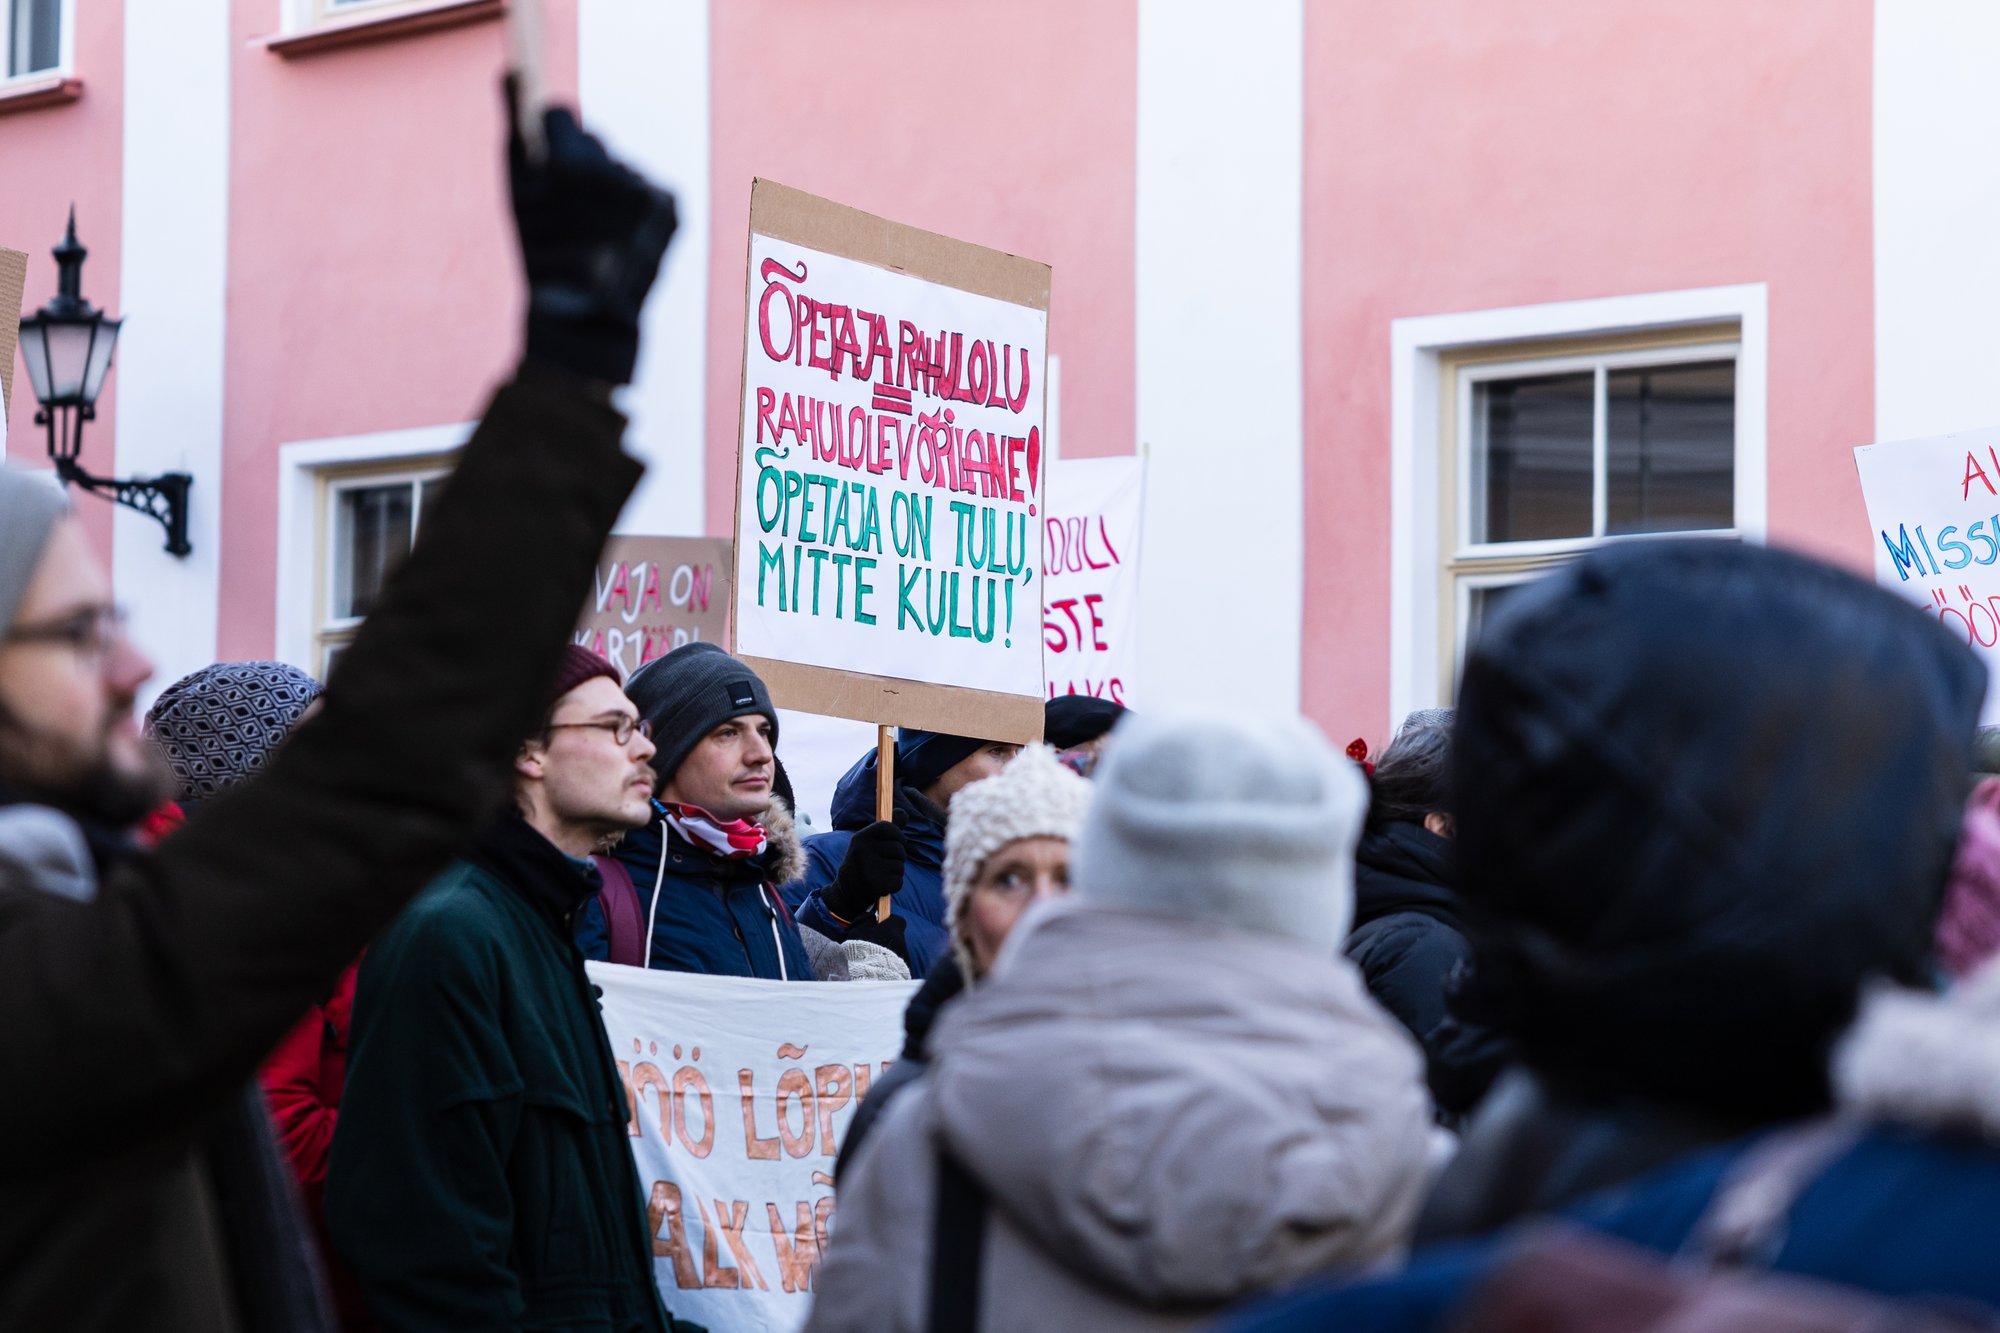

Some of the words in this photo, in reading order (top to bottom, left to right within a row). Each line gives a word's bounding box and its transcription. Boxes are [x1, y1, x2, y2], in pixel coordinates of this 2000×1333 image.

[758, 257, 894, 386] ÕPETAJA
[896, 319, 1031, 414] RAHULOLU
[756, 386, 916, 481] RAHULOLEV
[755, 446, 883, 555] ÕPETAJA
[891, 490, 933, 562] ON
[949, 500, 1033, 587] TULU,
[669, 563, 714, 614] ON
[757, 540, 878, 626] MITTE
[897, 563, 1014, 649] KULU!
[1921, 584, 2000, 648] ÖÖ
[737, 1042, 893, 1162] LÕP
